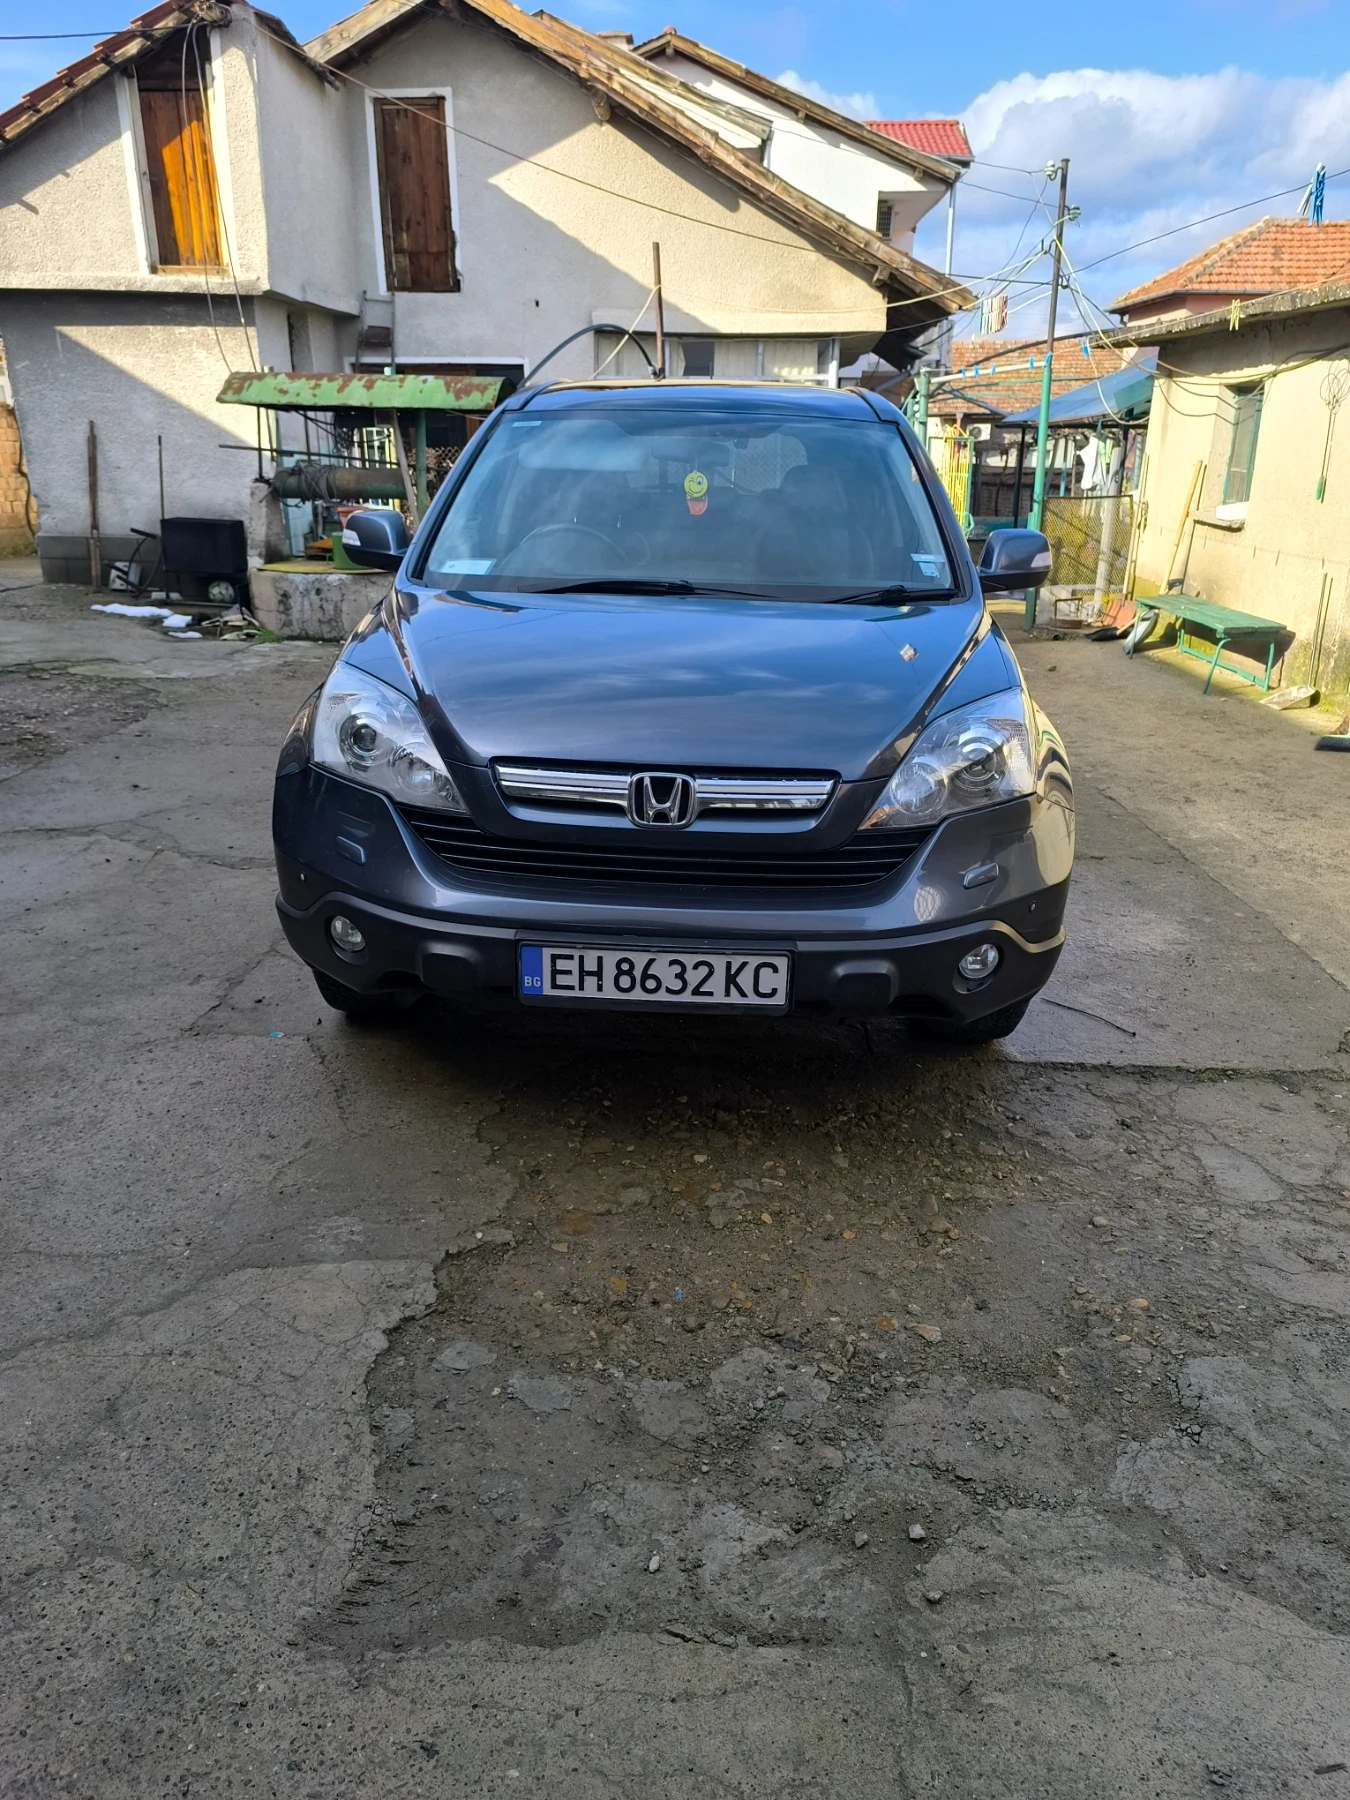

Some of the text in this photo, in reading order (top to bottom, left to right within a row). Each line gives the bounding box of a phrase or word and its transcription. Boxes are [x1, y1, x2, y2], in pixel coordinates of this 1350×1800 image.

[524, 976, 541, 987] BG
[550, 953, 778, 998] EH 8632 KC
